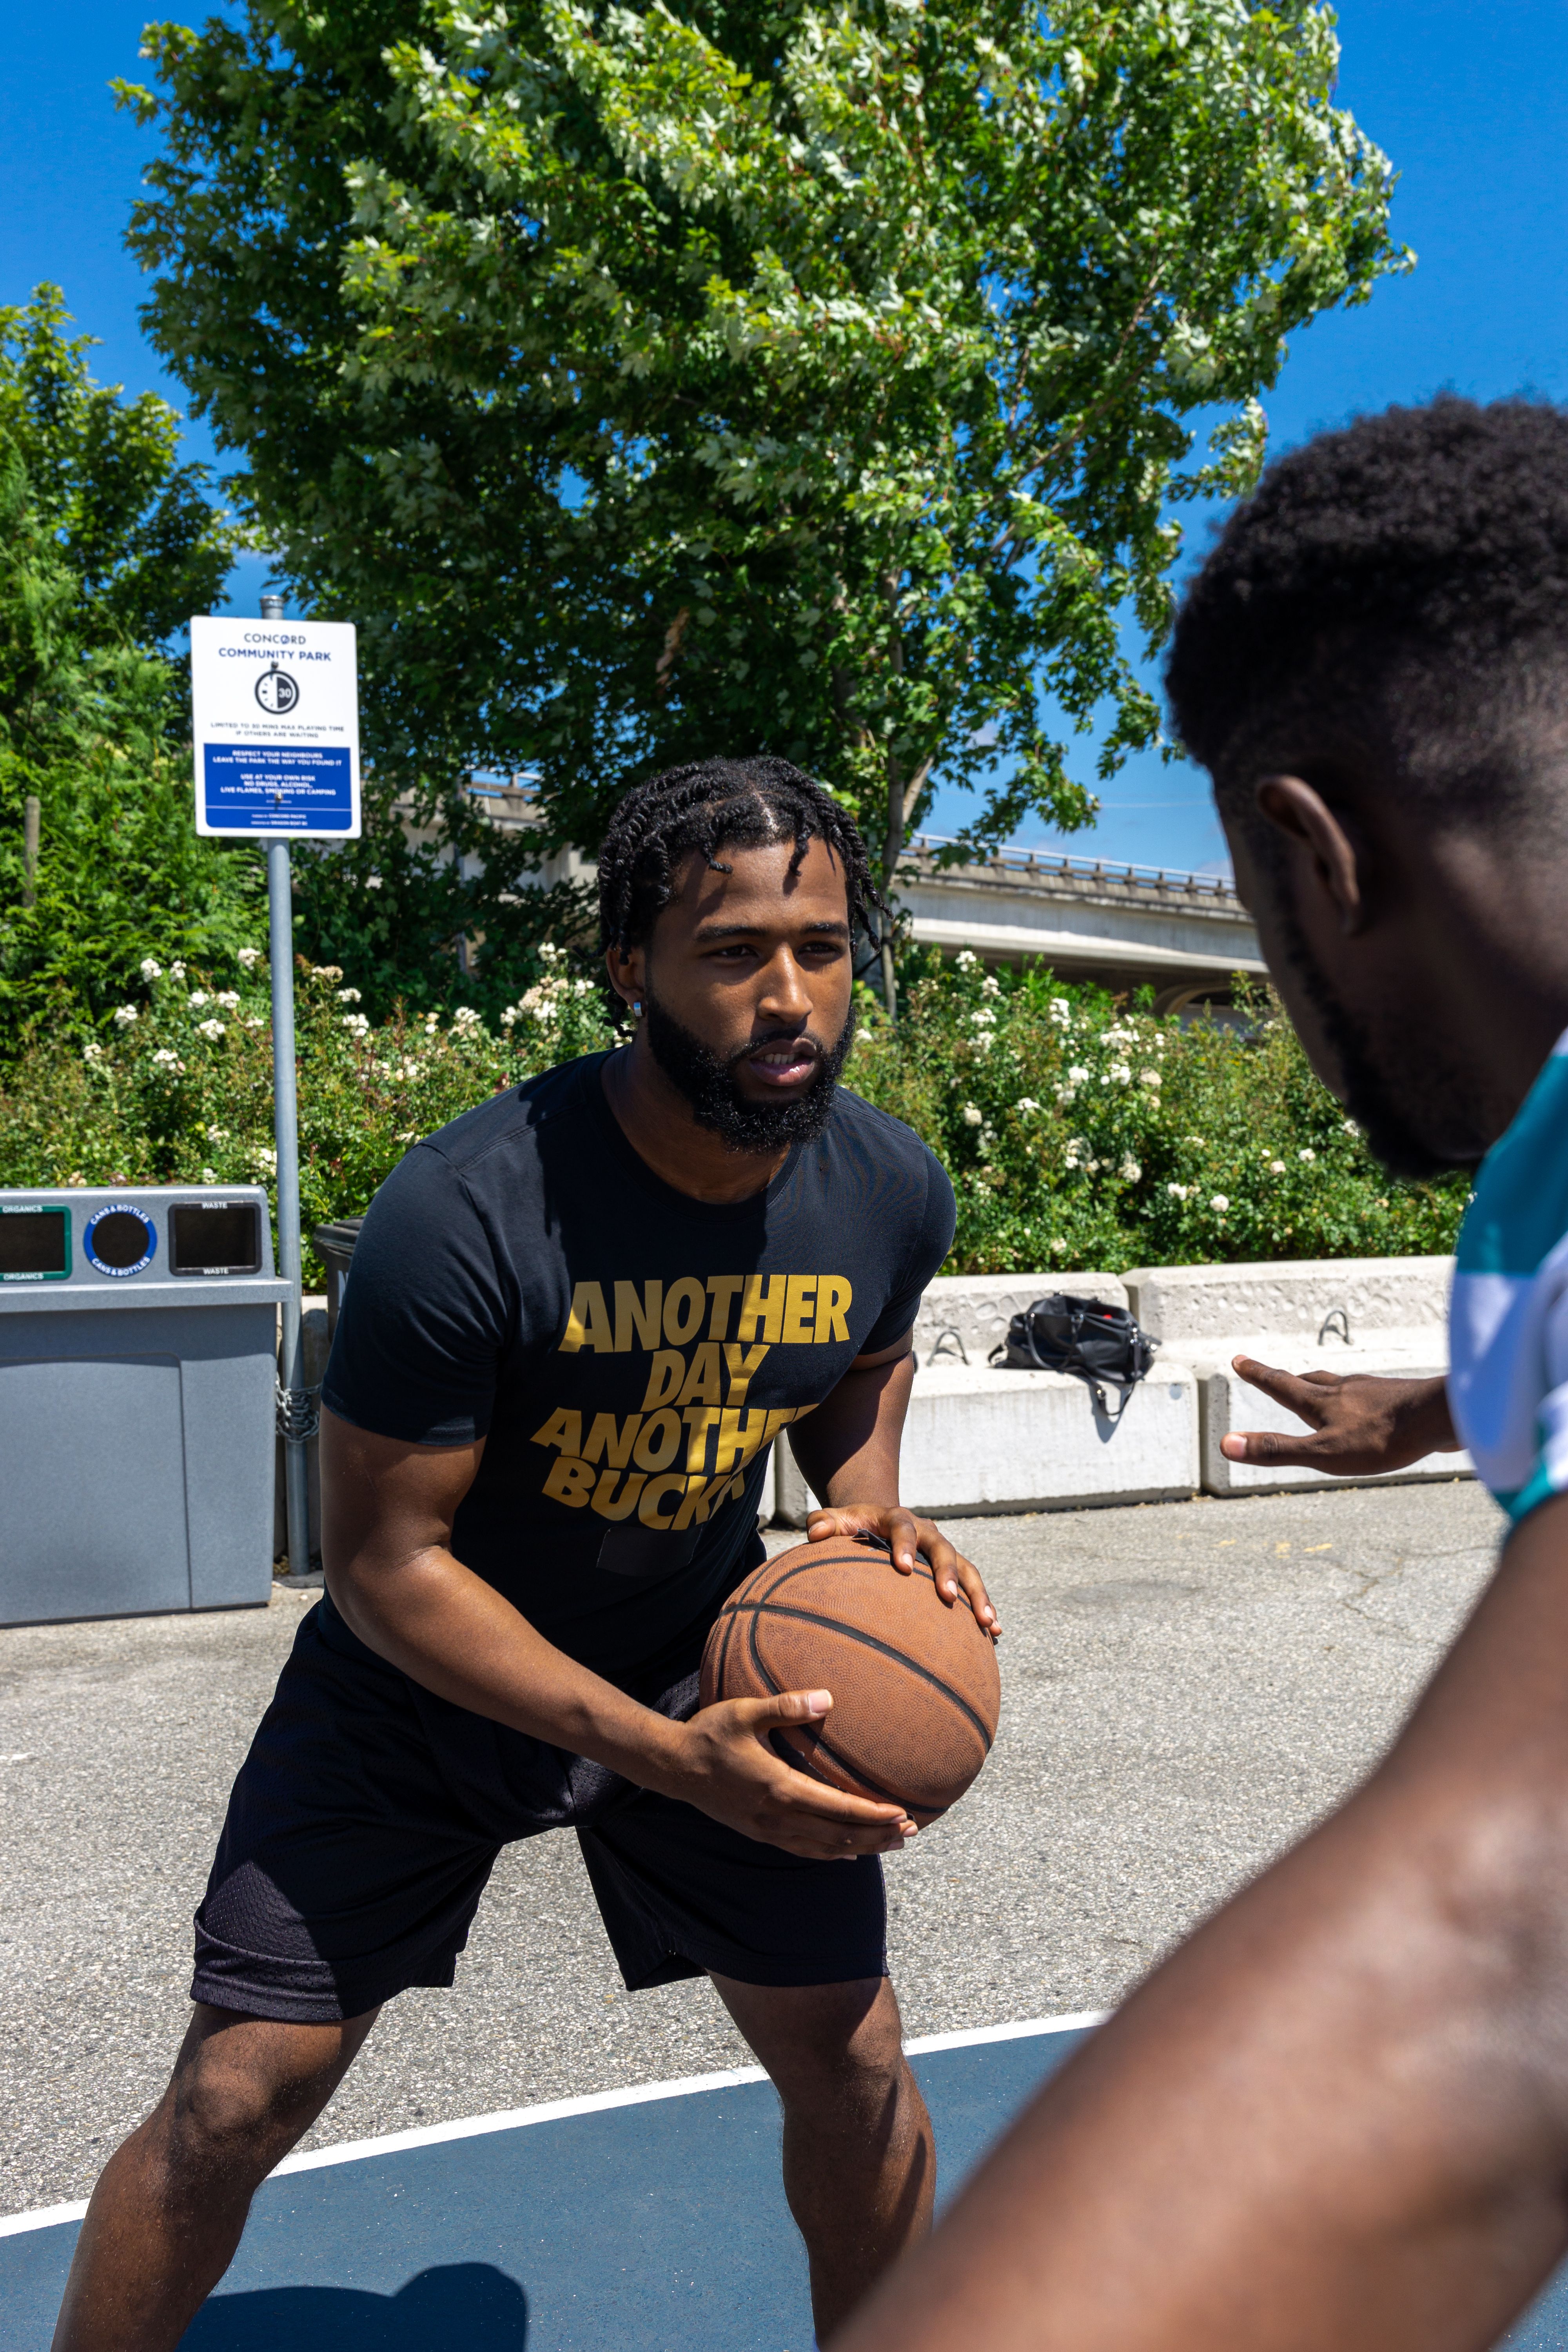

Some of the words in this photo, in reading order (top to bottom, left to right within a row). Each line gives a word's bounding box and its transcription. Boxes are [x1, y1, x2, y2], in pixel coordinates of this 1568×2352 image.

[219, 648, 294, 659] COMMUNITY
[299, 651, 331, 661] PARK
[278, 688, 291, 699] 30
[558, 1275, 852, 1353] ANOTHER
[640, 1343, 771, 1412] DAY
[530, 1403, 820, 1474] ANOTH
[542, 1457, 744, 1530] BUCK
